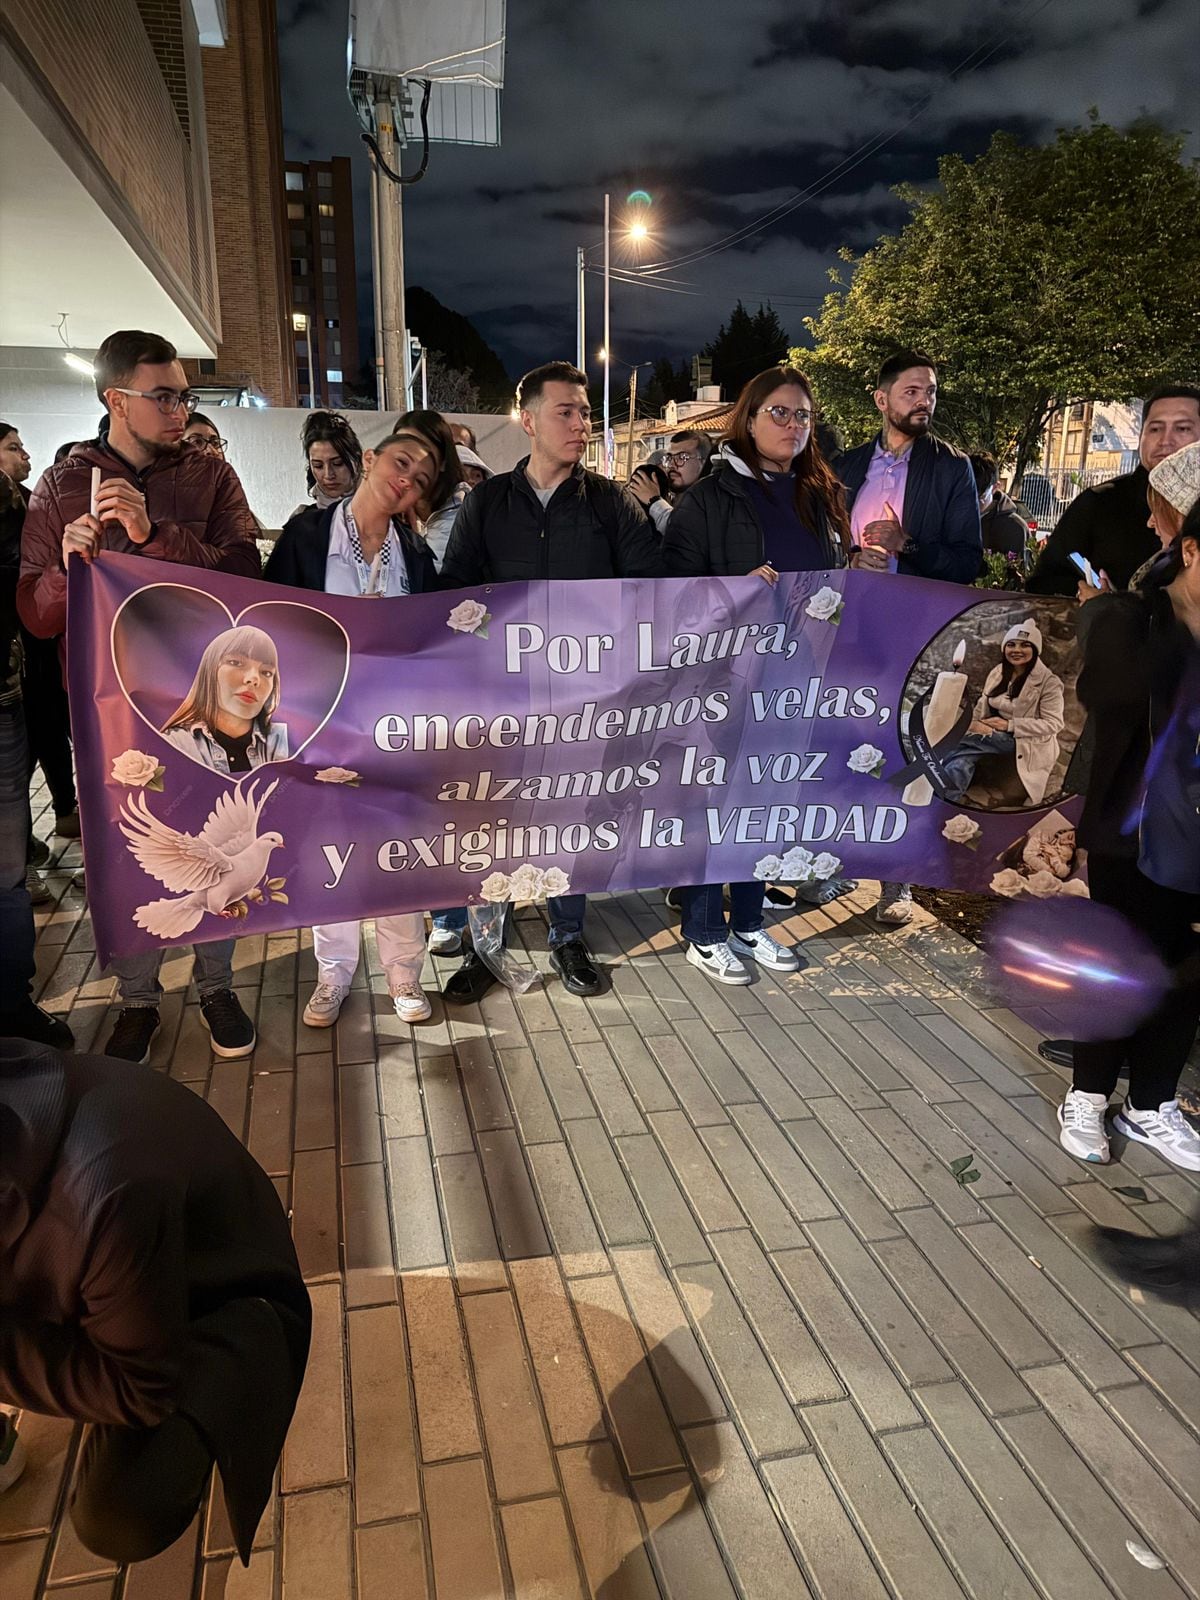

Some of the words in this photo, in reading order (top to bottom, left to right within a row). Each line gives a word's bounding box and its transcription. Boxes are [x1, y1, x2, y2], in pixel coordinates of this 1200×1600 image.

[505, 623, 614, 674] Por
[637, 621, 799, 672] Laura,
[374, 690, 730, 752] encendemos
[751, 677, 892, 725] velas,
[437, 758, 661, 802] alzamos
[680, 747, 727, 786] la
[747, 752, 828, 783] voz
[322, 843, 357, 889] y
[377, 818, 620, 873] exigimos
[639, 808, 685, 849] la
[706, 804, 909, 845] VERDAD
